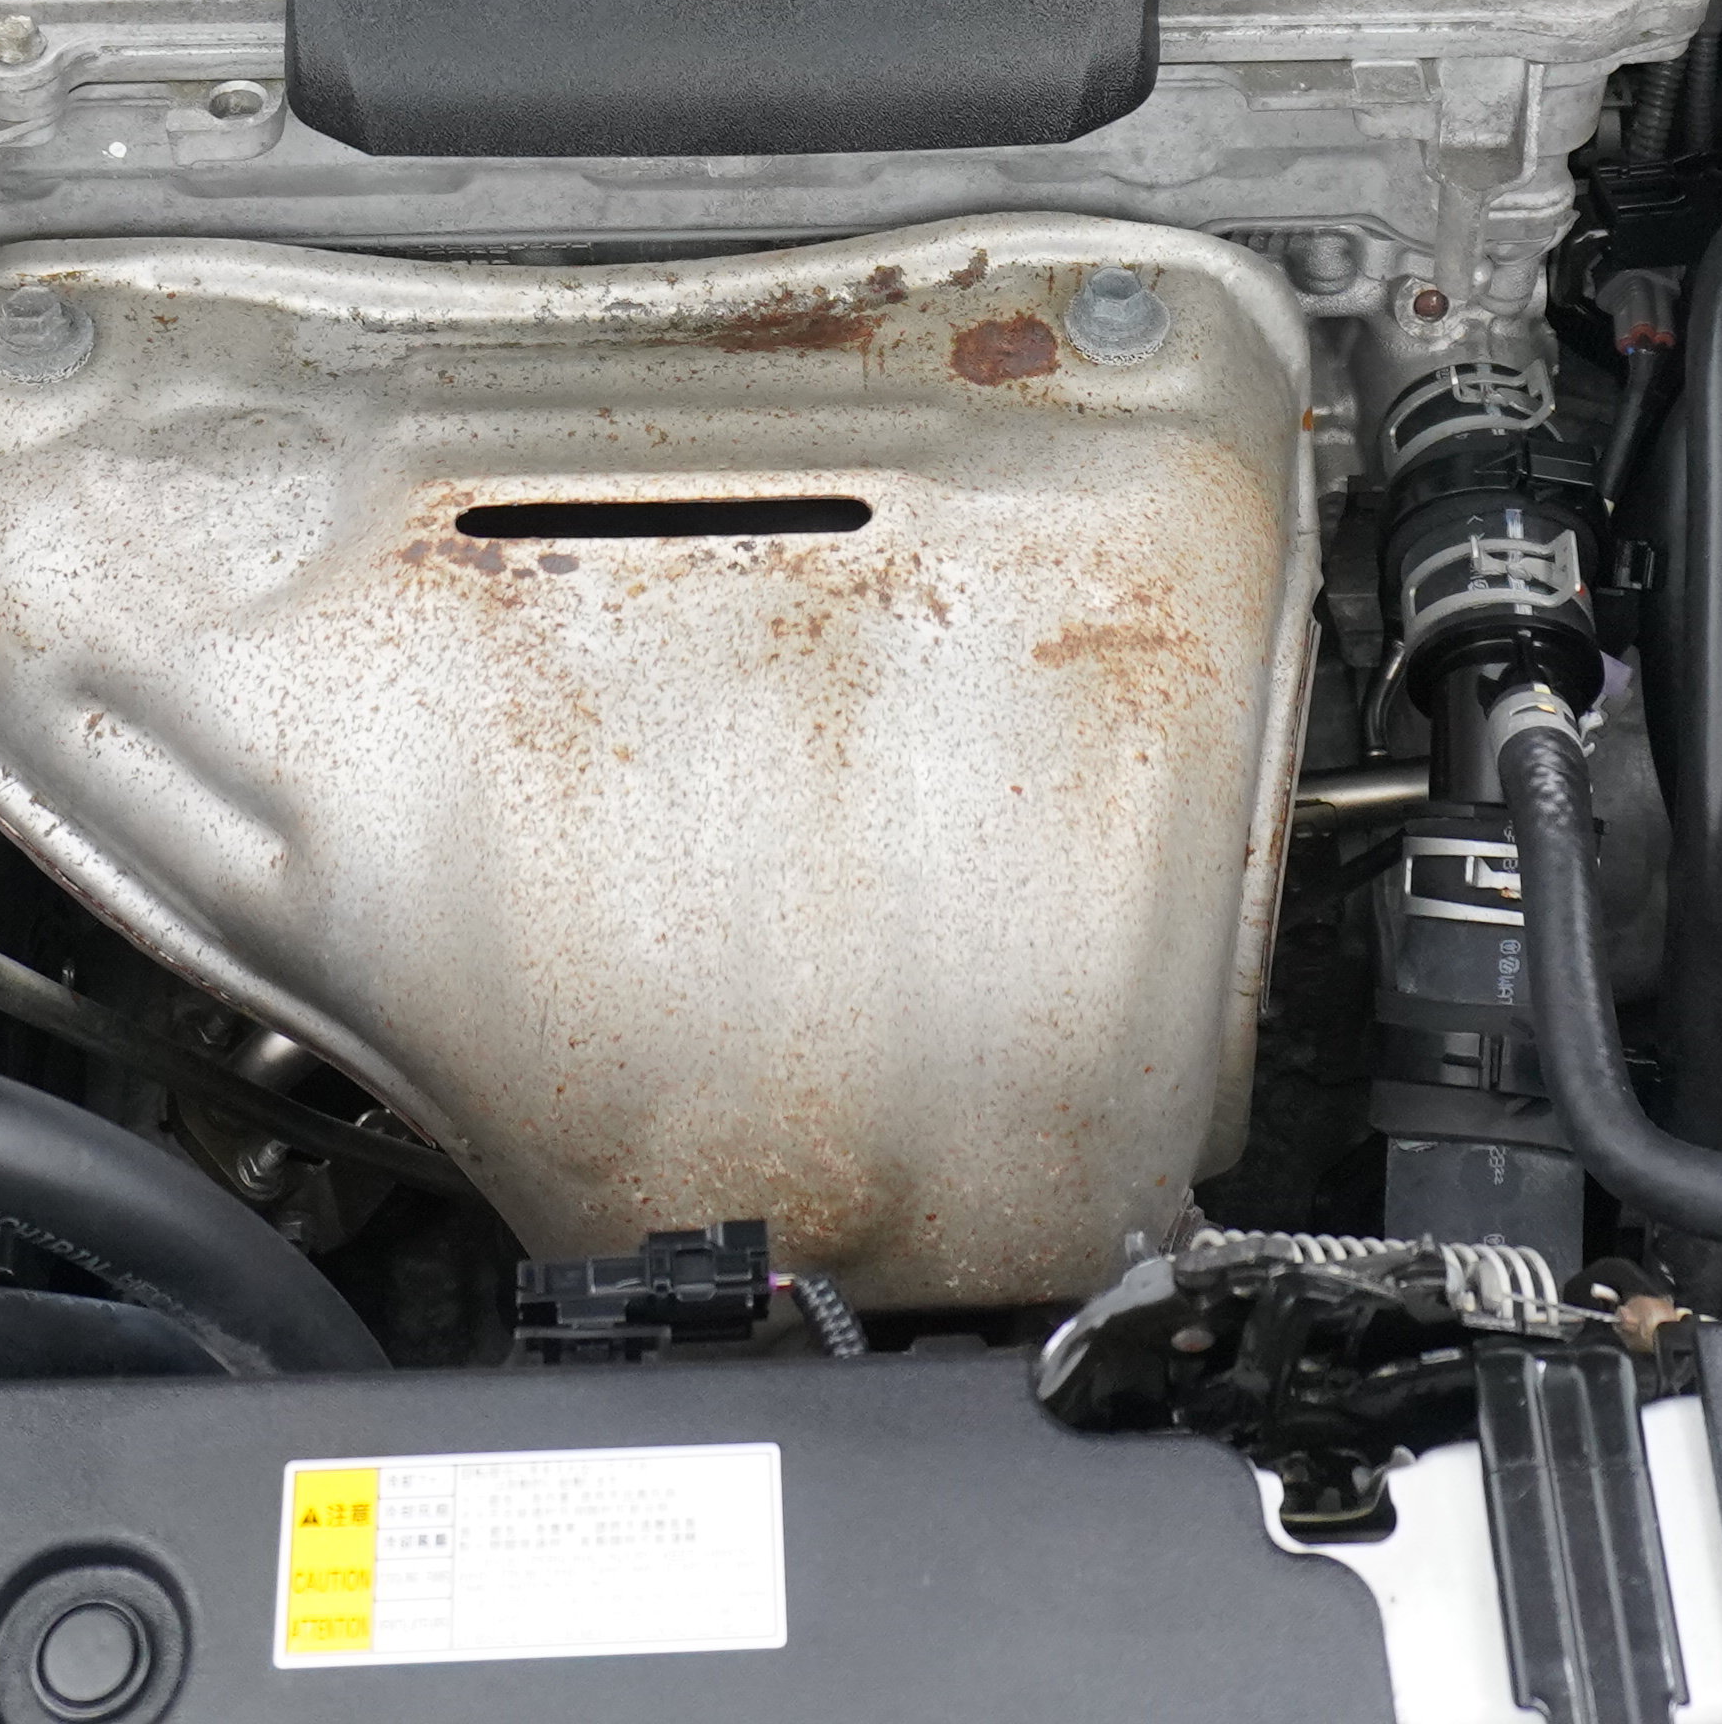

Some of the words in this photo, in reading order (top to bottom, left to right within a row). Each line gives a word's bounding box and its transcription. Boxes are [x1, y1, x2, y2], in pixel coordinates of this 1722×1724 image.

[326, 1503, 371, 1528] 注意
[291, 1570, 371, 1594] CAUTION
[292, 1618, 369, 1640] ATTENTION
